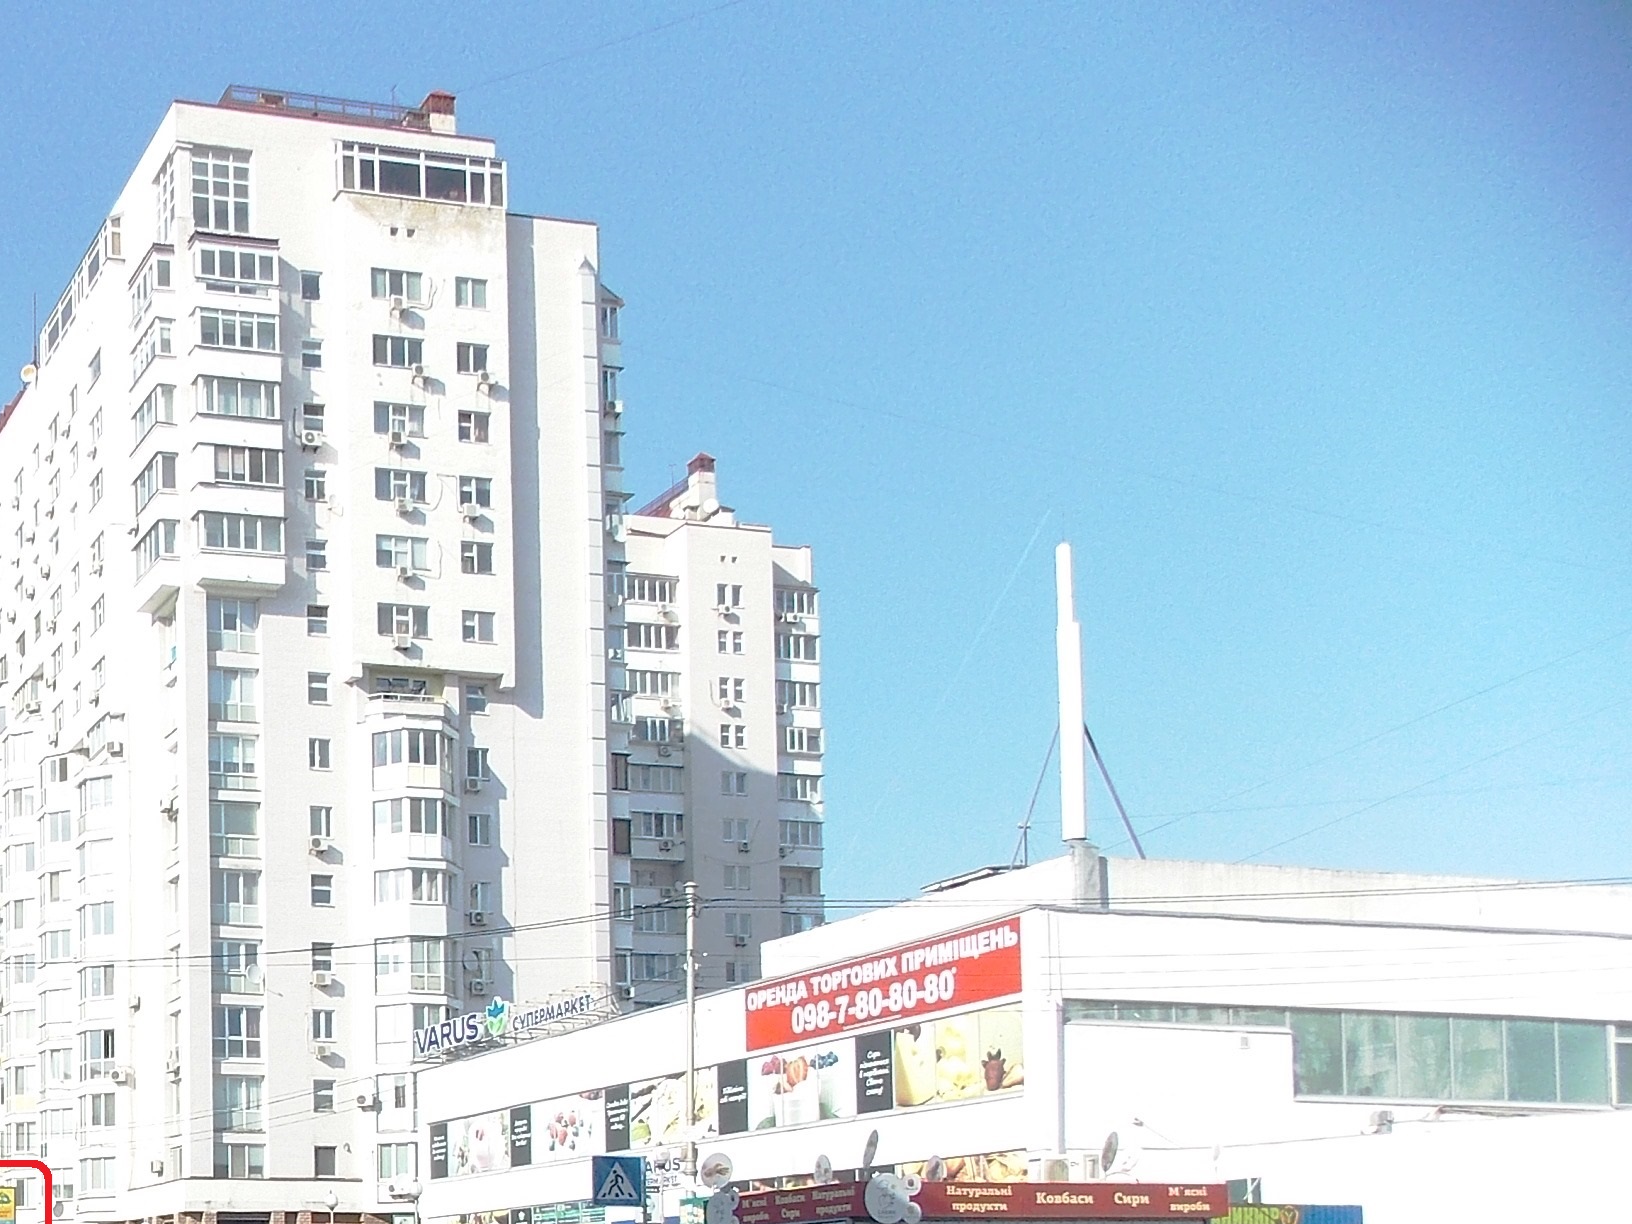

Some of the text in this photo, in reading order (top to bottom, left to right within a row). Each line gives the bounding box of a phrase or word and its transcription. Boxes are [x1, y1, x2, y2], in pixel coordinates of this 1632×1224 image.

[747, 925, 1018, 1011] ОРЕНДА ТОРГОВИХ ПРИМІЩЕНЬ
[512, 994, 592, 1032] СУПЕРМАРКЕТ
[416, 1015, 479, 1054] VARUS
[946, 1186, 1013, 1197] Натуральні
[1036, 1191, 1150, 1208] Ковбаси Сири
[952, 1202, 1008, 1212] продукти
[1170, 1201, 1210, 1212] вироби
